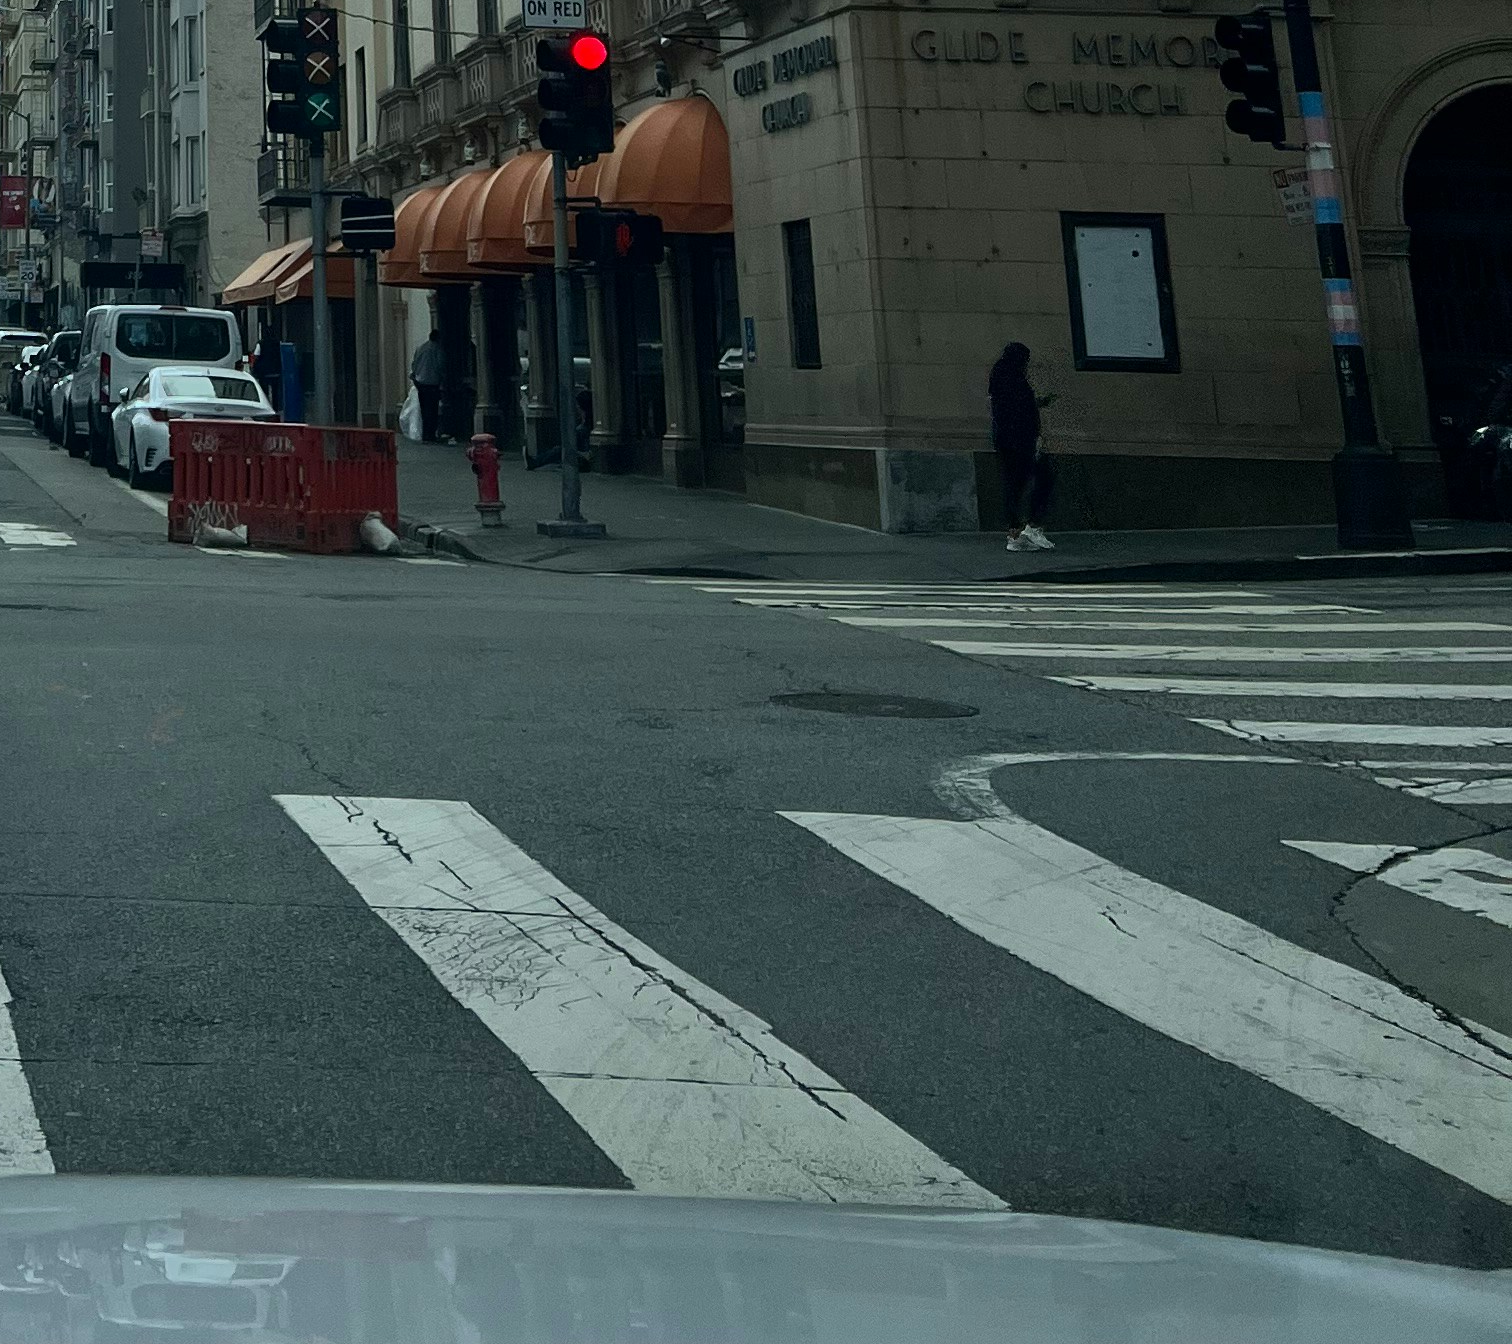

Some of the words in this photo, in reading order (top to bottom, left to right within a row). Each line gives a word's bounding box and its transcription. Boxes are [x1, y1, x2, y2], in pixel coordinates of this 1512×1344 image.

[527, 0, 547, 16] ON
[554, 1, 582, 17] RED
[911, 30, 1029, 64] GLIDE
[1073, 32, 1224, 67] MEMOR
[1024, 81, 1183, 114] CHURCH
[21, 272, 34, 280] 20
